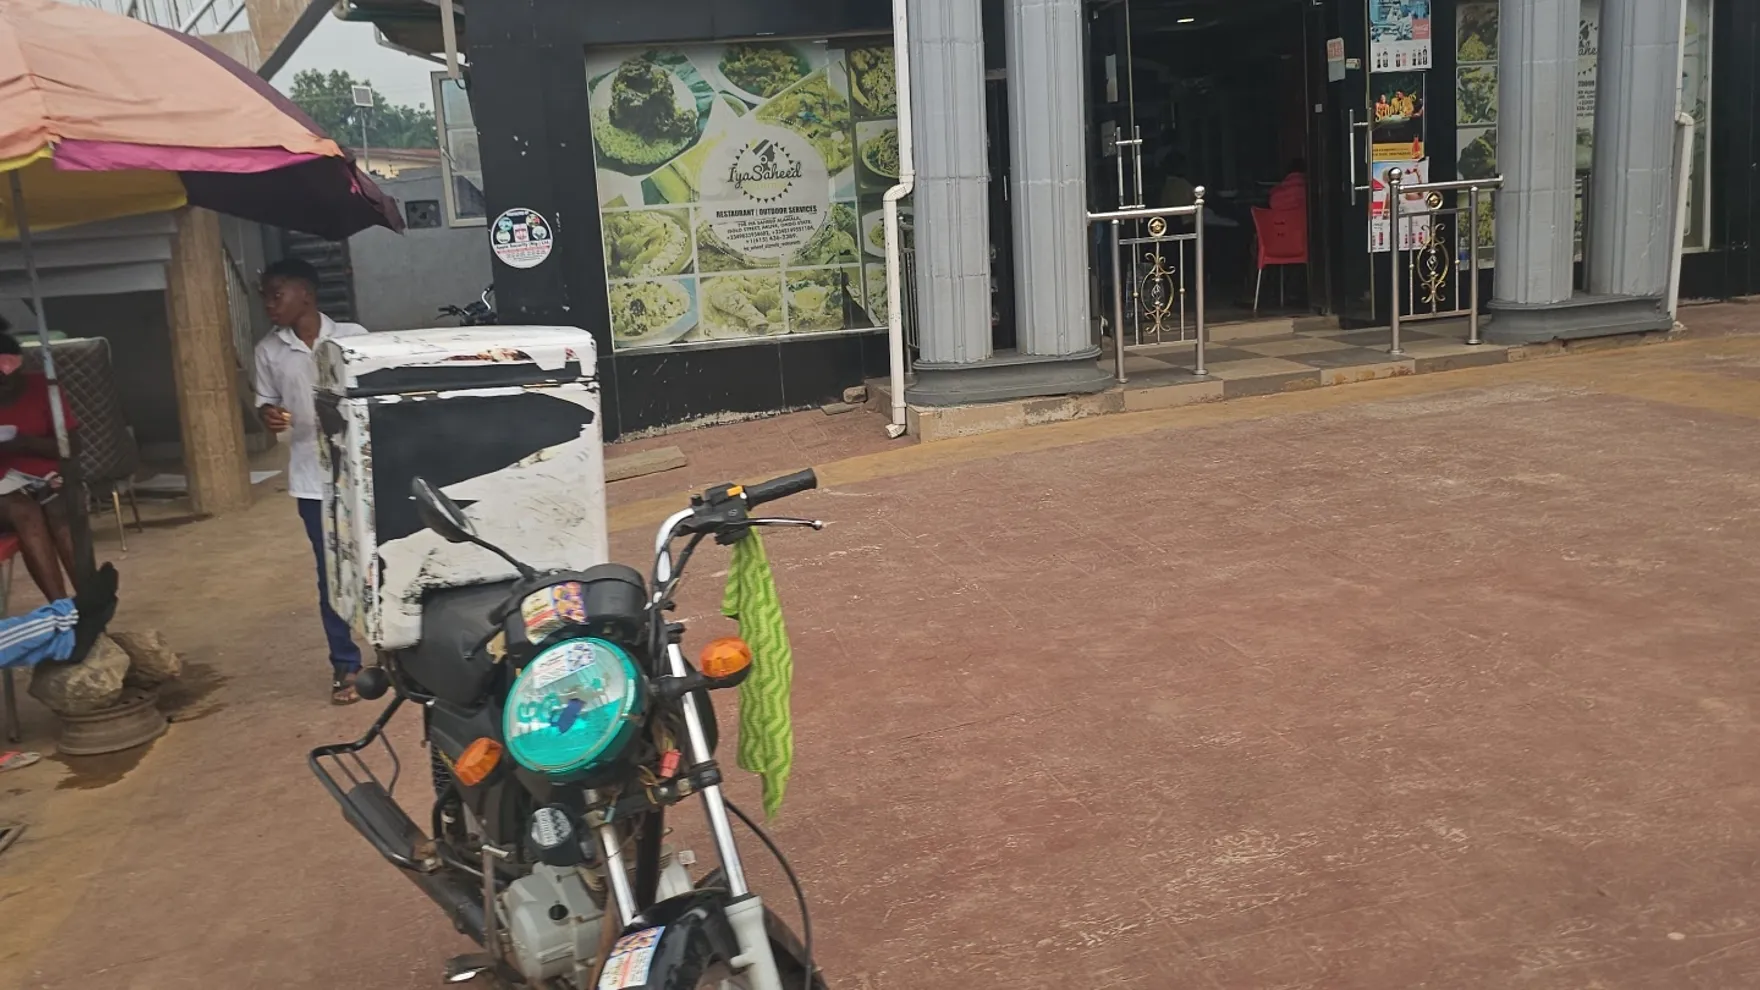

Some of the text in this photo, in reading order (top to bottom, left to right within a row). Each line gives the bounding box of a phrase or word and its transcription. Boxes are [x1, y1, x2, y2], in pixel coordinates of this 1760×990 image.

[716, 208, 754, 218] RESTAURANT
[759, 207, 787, 215] OUTDOOR
[788, 205, 817, 214] SERVICES
